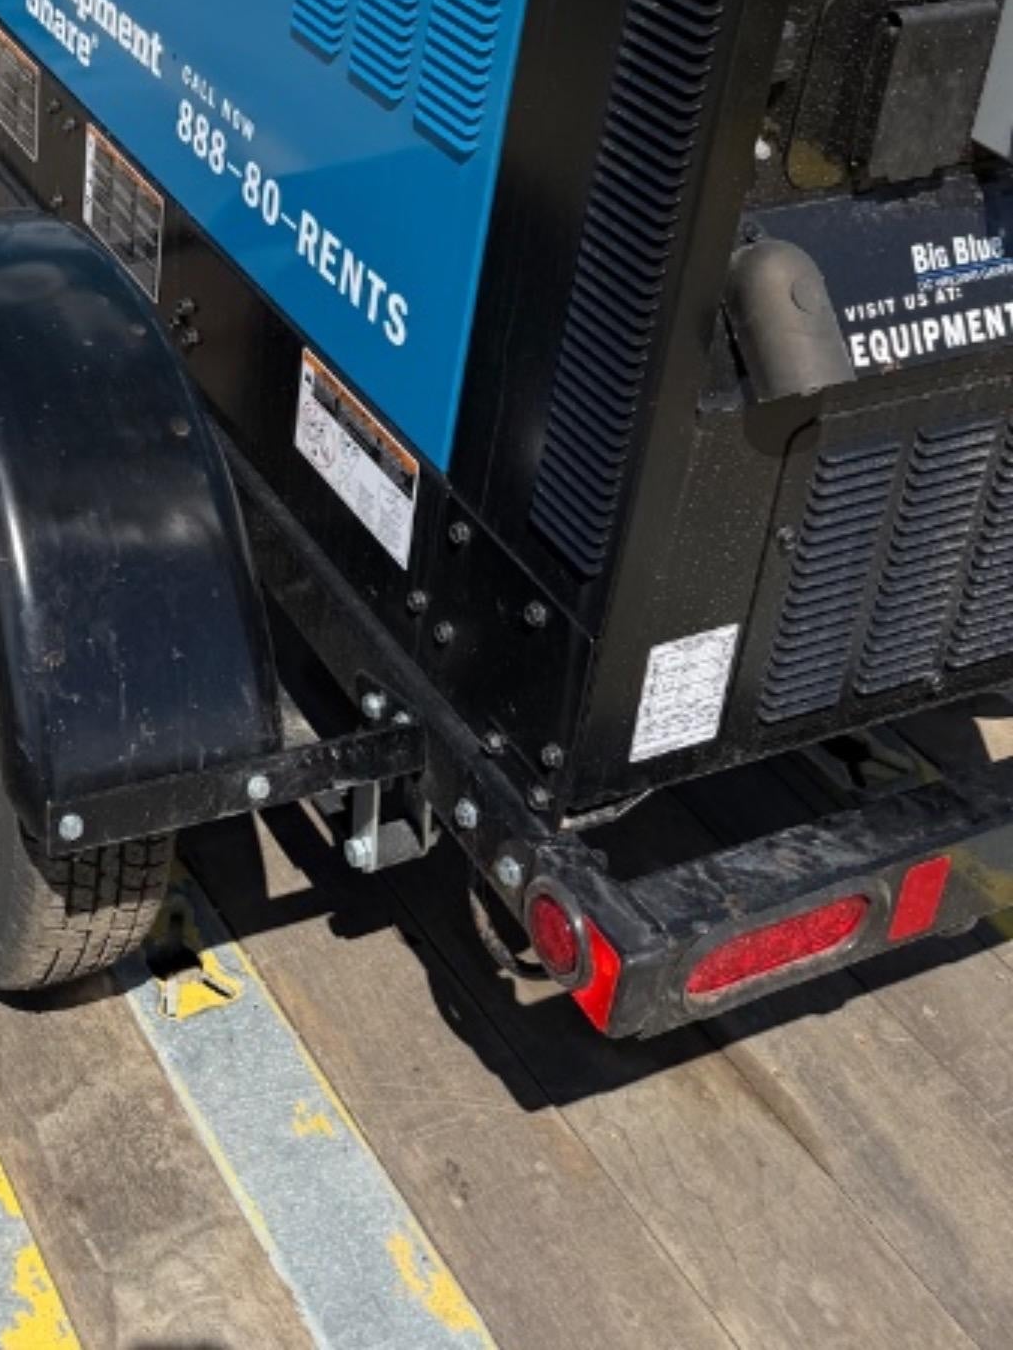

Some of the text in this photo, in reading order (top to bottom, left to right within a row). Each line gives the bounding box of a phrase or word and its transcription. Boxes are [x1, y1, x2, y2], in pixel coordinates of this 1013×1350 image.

[181, 64, 255, 142] CALL NOW
[175, 97, 409, 347] 888-80-RENTS
[910, 233, 1005, 274] Big Blue
[844, 286, 964, 322] VISIT US AT:
